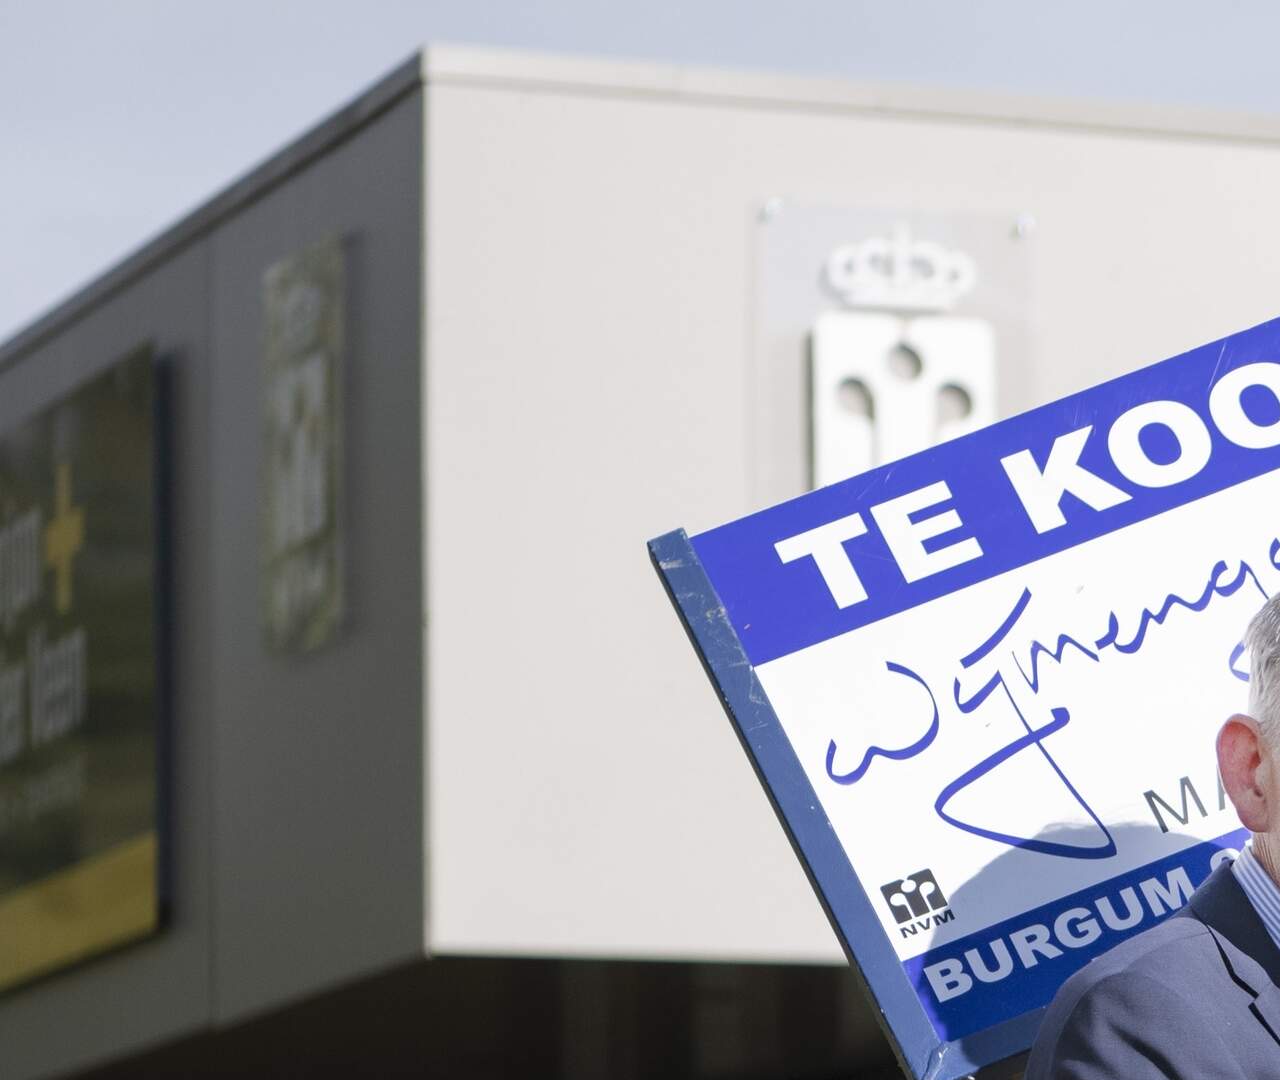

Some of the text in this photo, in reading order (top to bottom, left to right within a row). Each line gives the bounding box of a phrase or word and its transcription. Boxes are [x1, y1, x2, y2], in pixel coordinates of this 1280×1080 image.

[774, 481, 983, 611] TE
[900, 909, 956, 939] NVM
[923, 866, 1196, 1003] BURGUM
